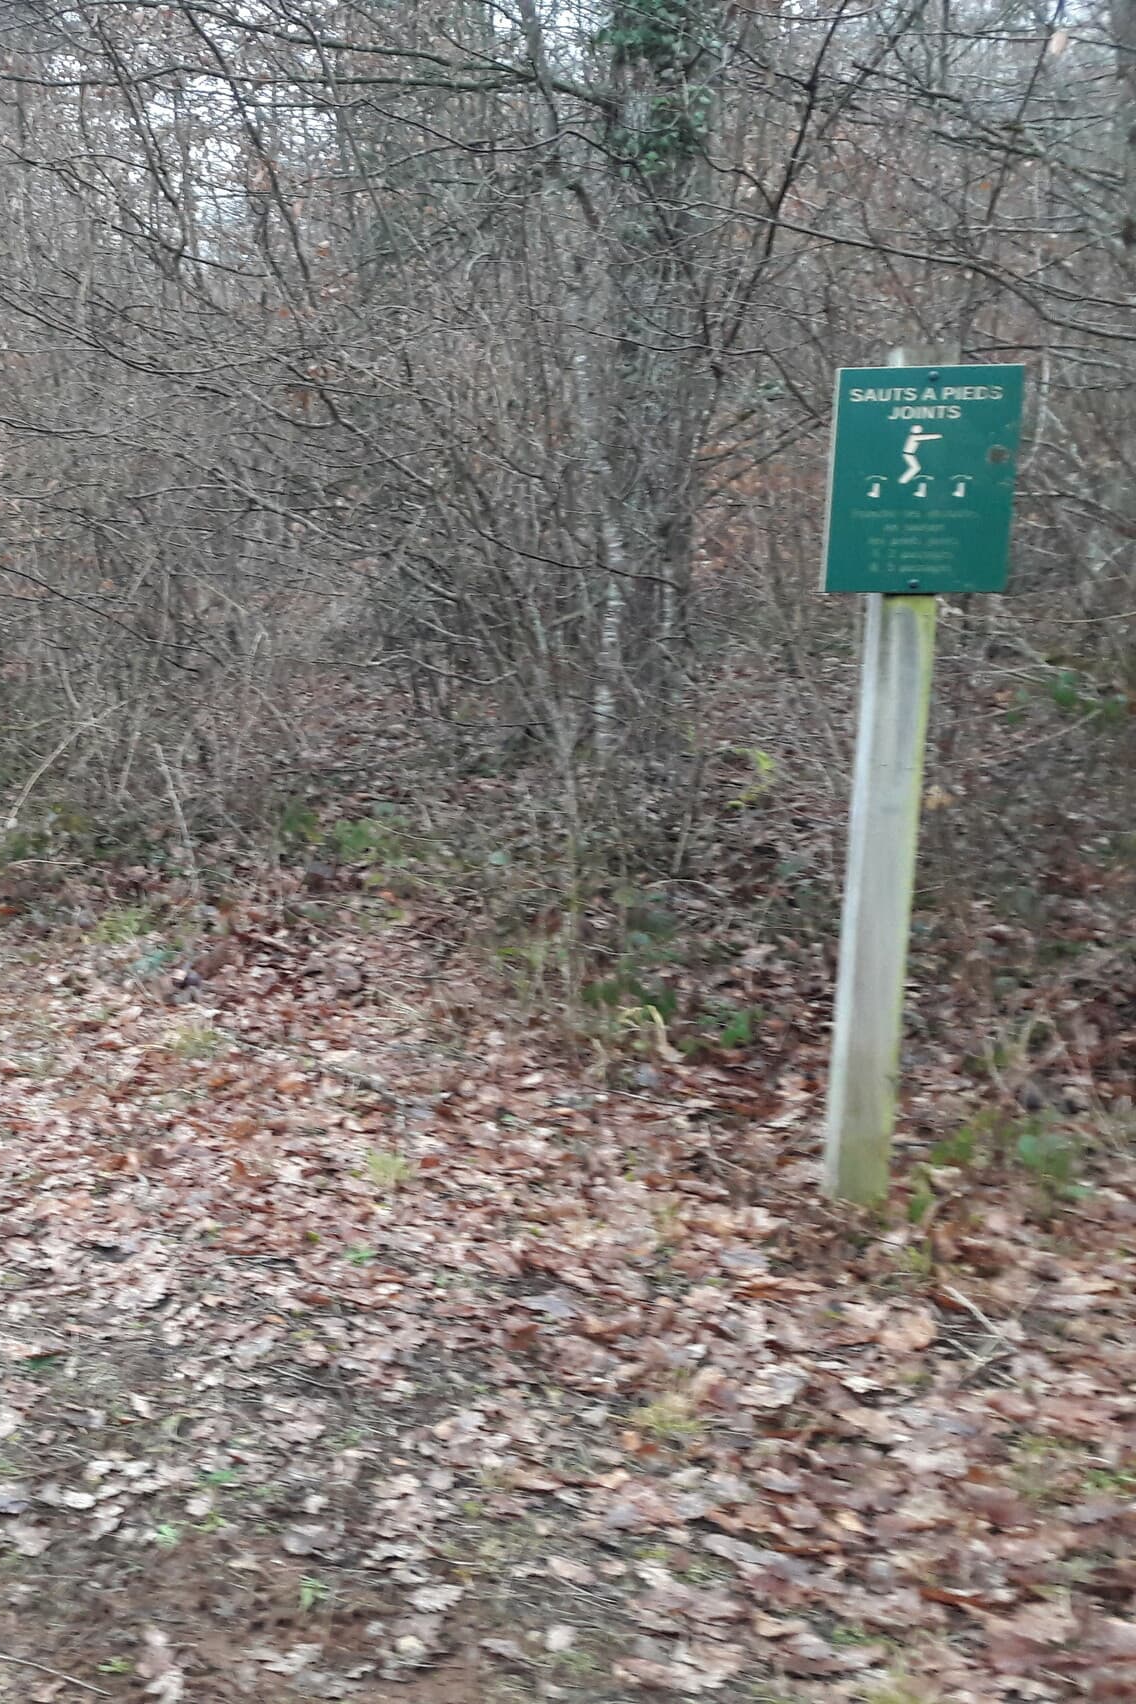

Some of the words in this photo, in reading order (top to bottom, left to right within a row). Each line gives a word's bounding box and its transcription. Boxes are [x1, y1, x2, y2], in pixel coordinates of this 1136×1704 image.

[849, 387, 918, 402] SAUTS
[921, 387, 938, 401] A
[943, 385, 1004, 401] PIEDS
[887, 405, 962, 420] JOINTS
